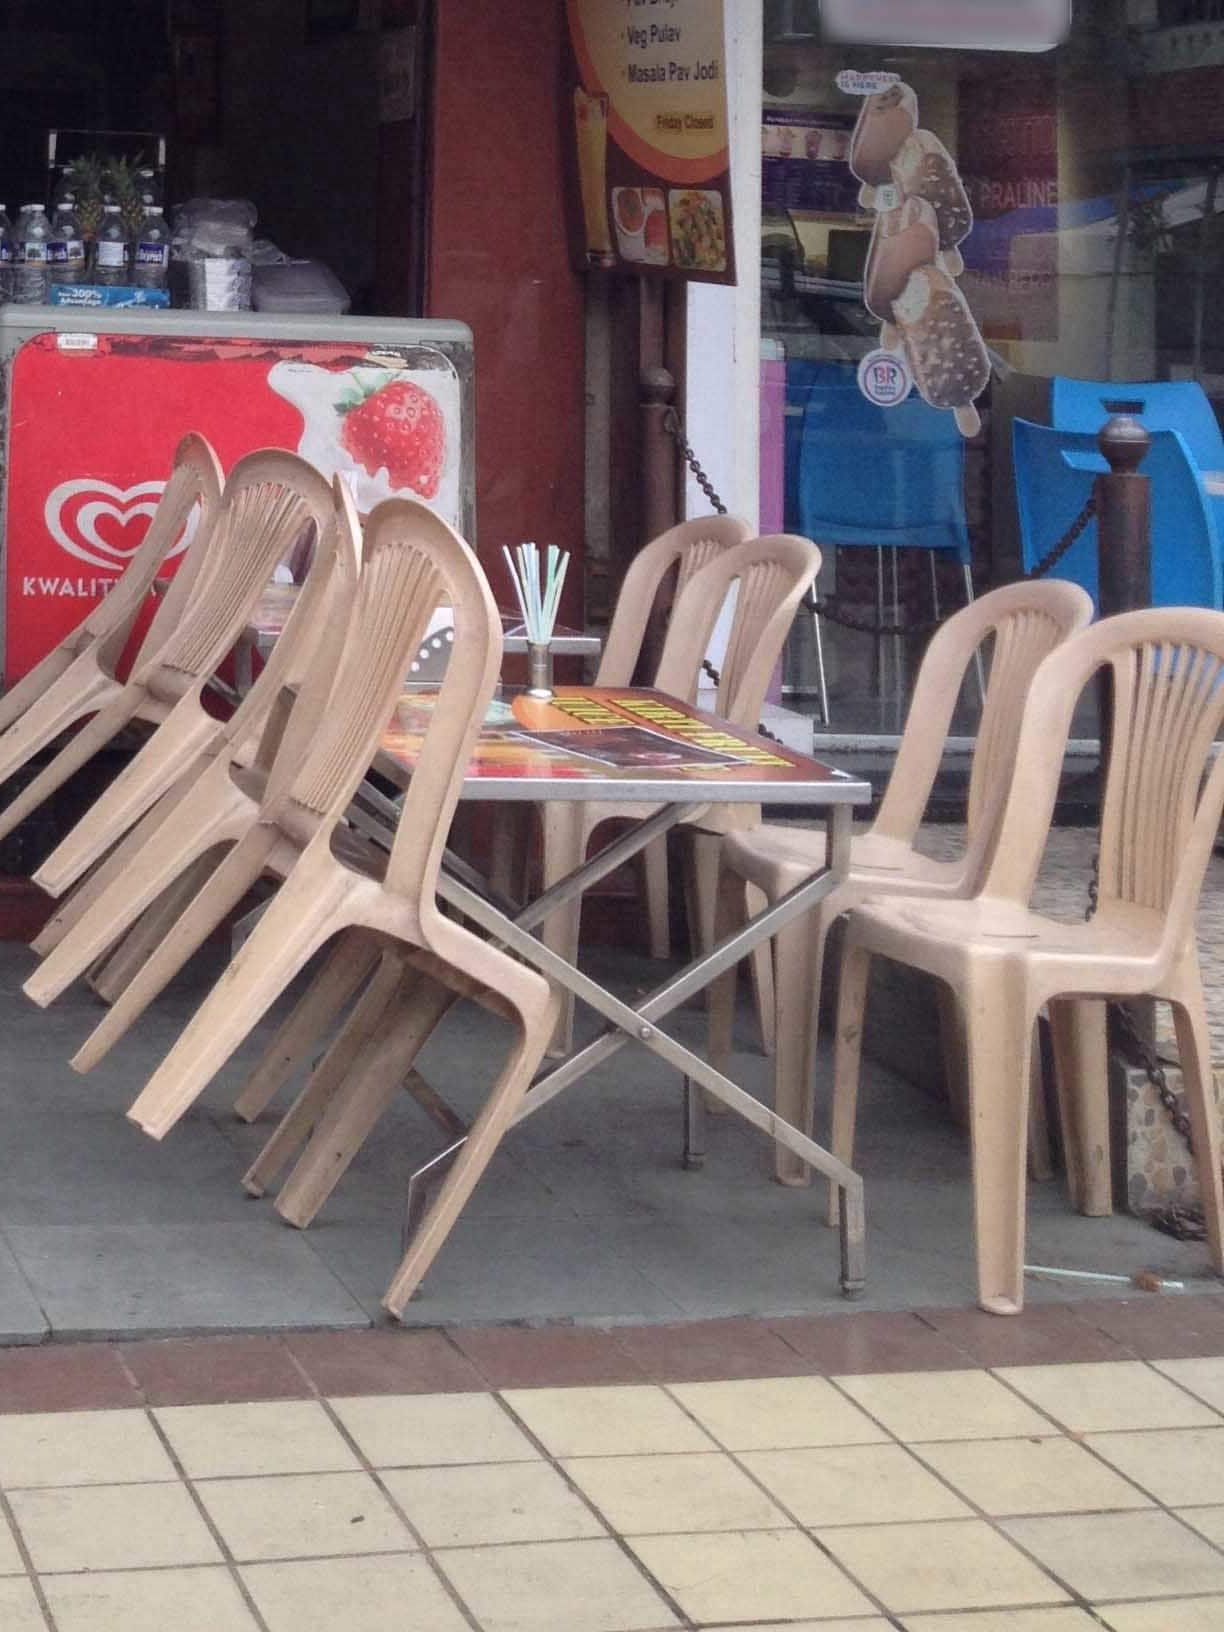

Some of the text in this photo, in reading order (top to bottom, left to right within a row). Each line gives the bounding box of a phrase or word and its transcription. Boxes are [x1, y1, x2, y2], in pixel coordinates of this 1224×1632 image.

[626, 25, 647, 48] Veg
[628, 63, 666, 82] Masala
[669, 61, 690, 80] Pav
[981, 180, 1058, 209] PRALINE
[22, 576, 120, 597] KWALIT
